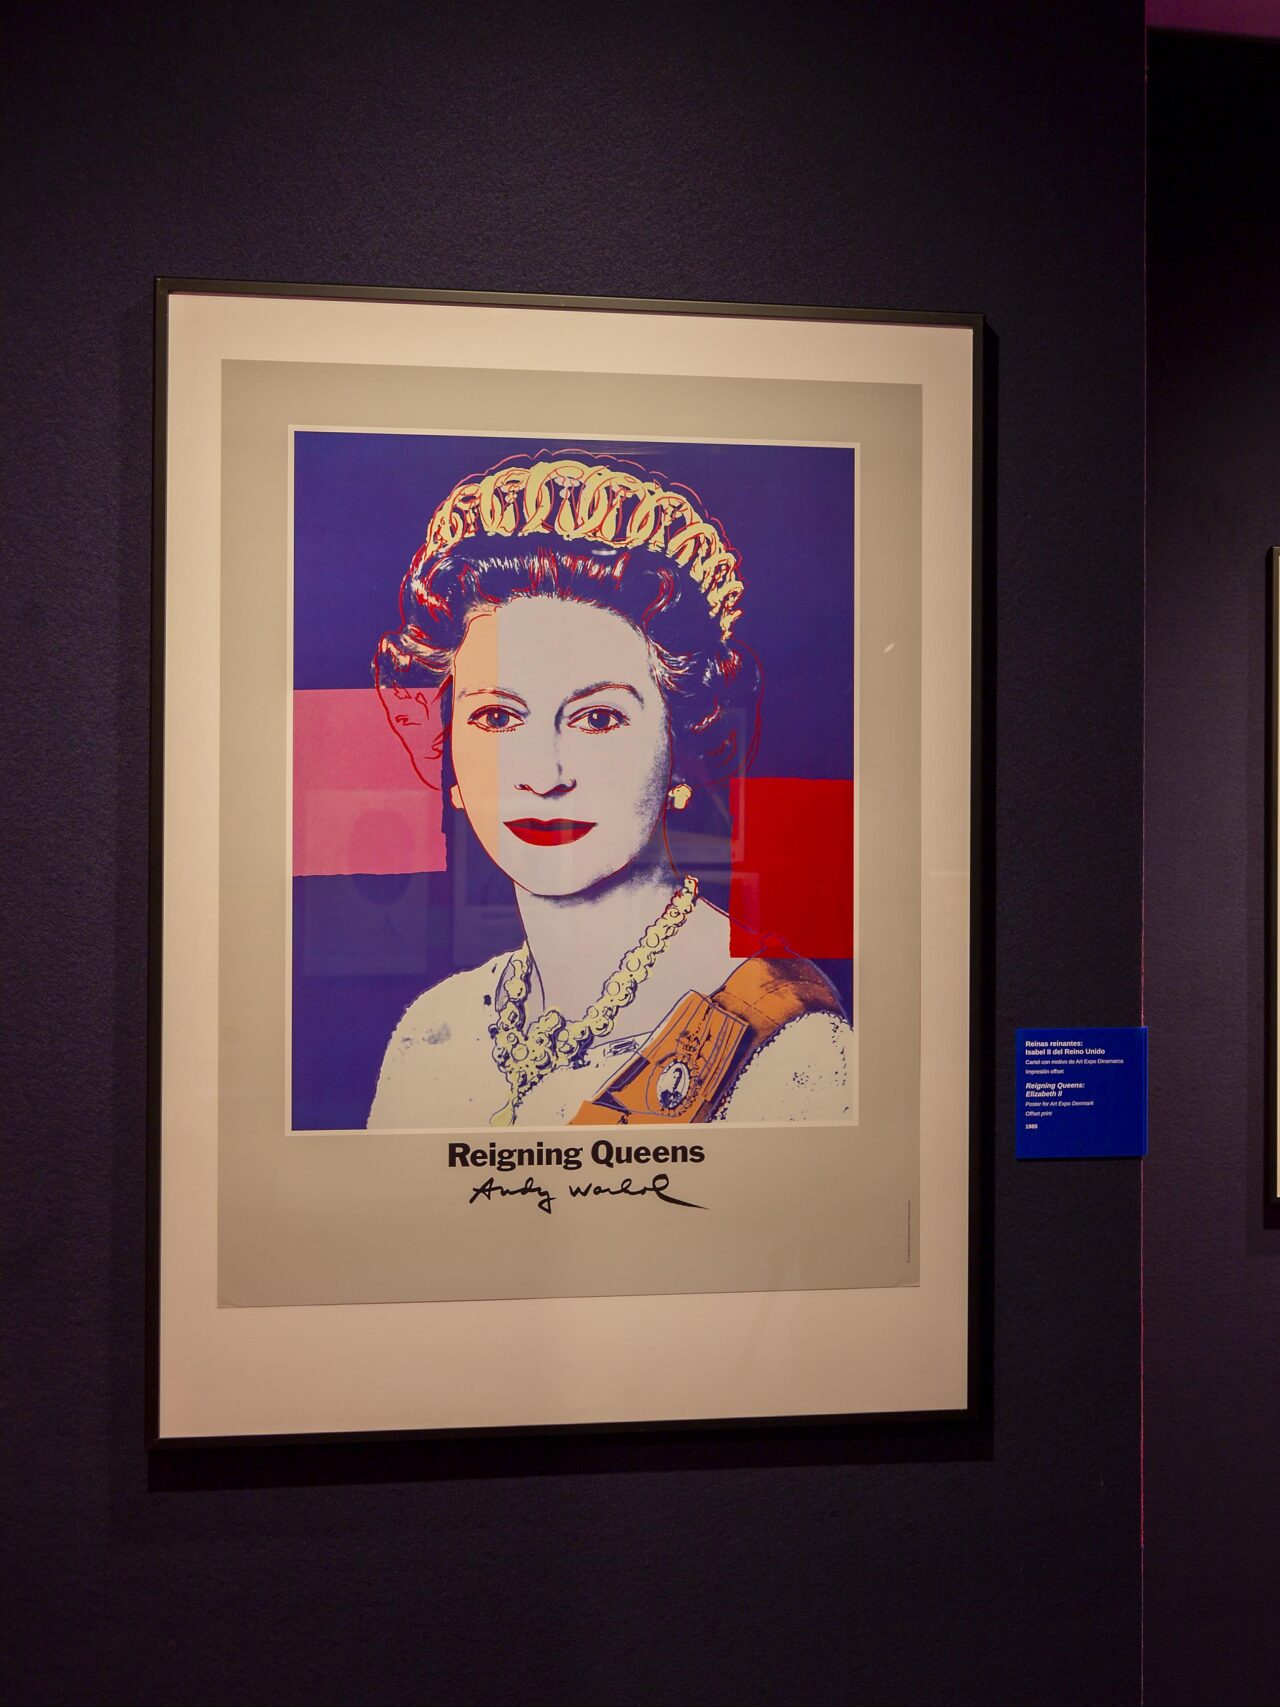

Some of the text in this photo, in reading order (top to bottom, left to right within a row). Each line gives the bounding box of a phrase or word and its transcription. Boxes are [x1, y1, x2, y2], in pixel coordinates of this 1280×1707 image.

[448, 1139, 705, 1171] Reigning Queens
[469, 1173, 710, 1215] Andy Warhol
